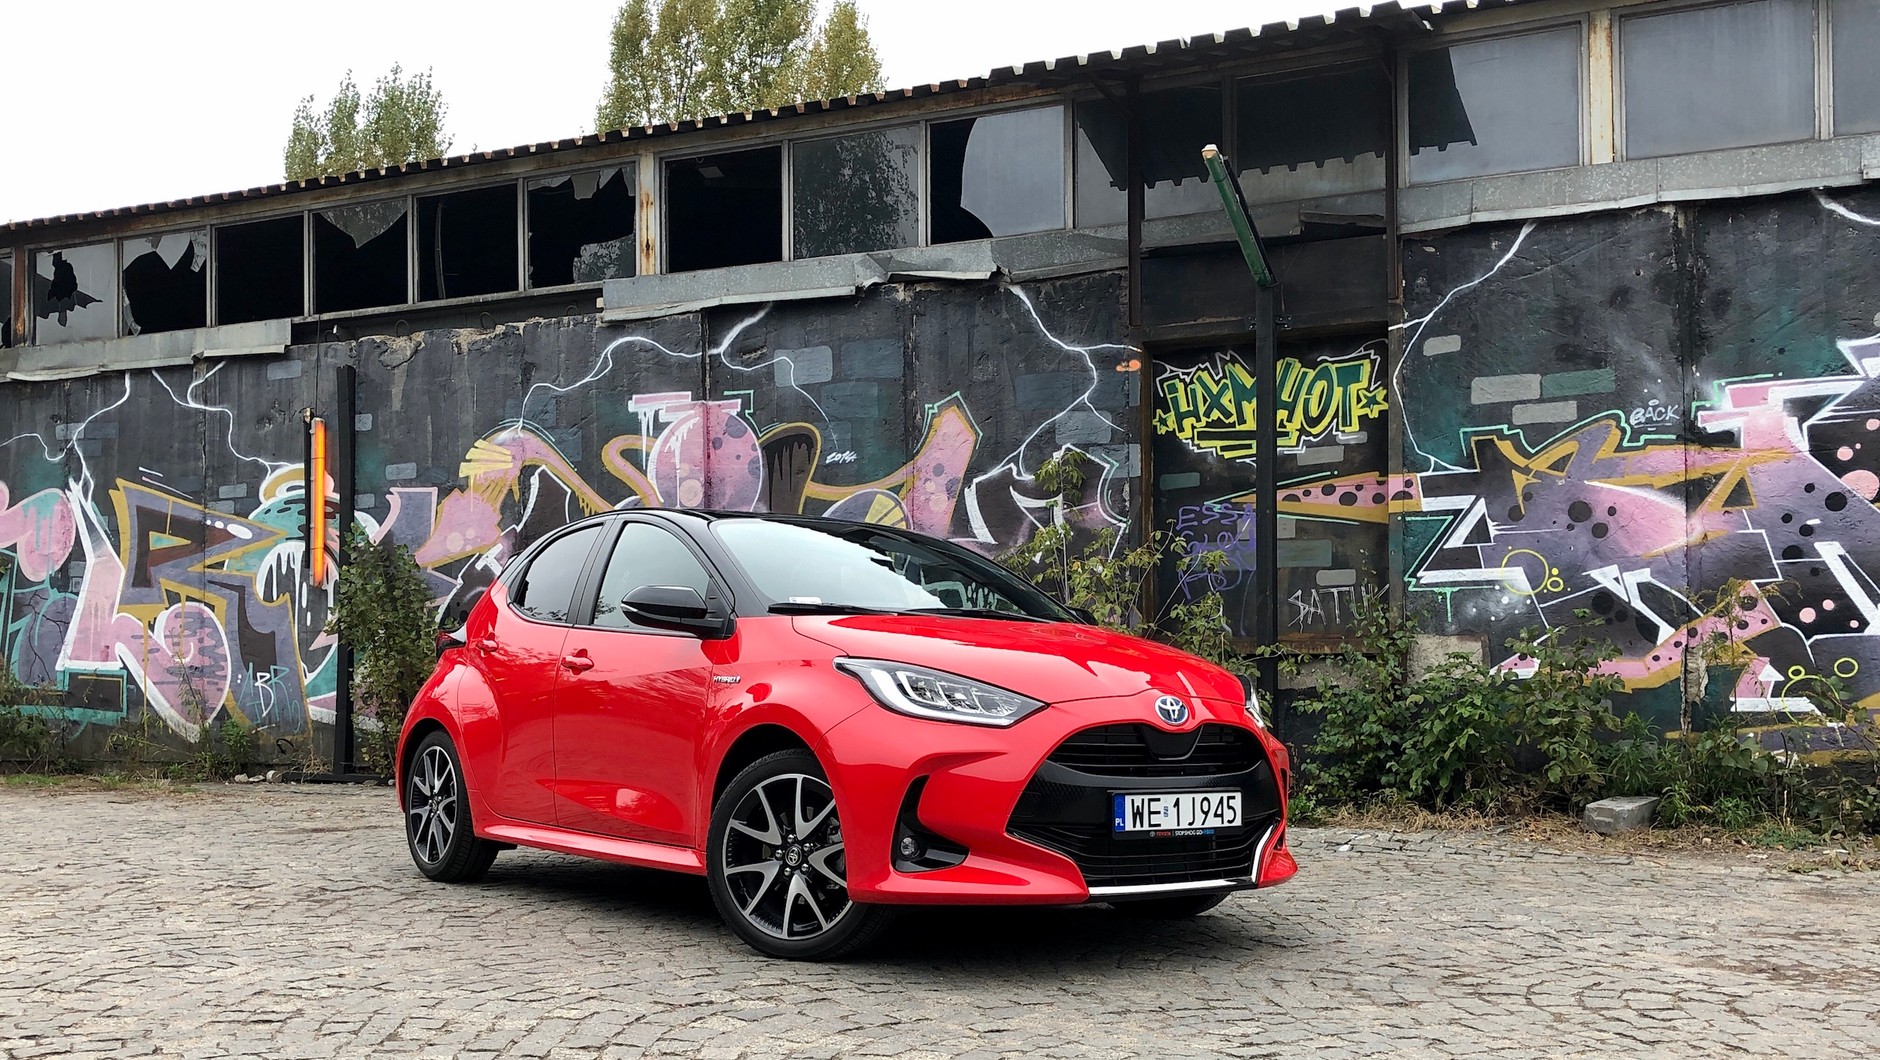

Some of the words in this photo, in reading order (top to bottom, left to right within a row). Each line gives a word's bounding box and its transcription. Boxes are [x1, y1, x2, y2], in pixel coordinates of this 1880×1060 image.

[1630, 404, 1680, 426] BACK
[1115, 817, 1124, 827] PL
[1131, 797, 1162, 829] WE
[1172, 795, 1237, 828] 1J945
